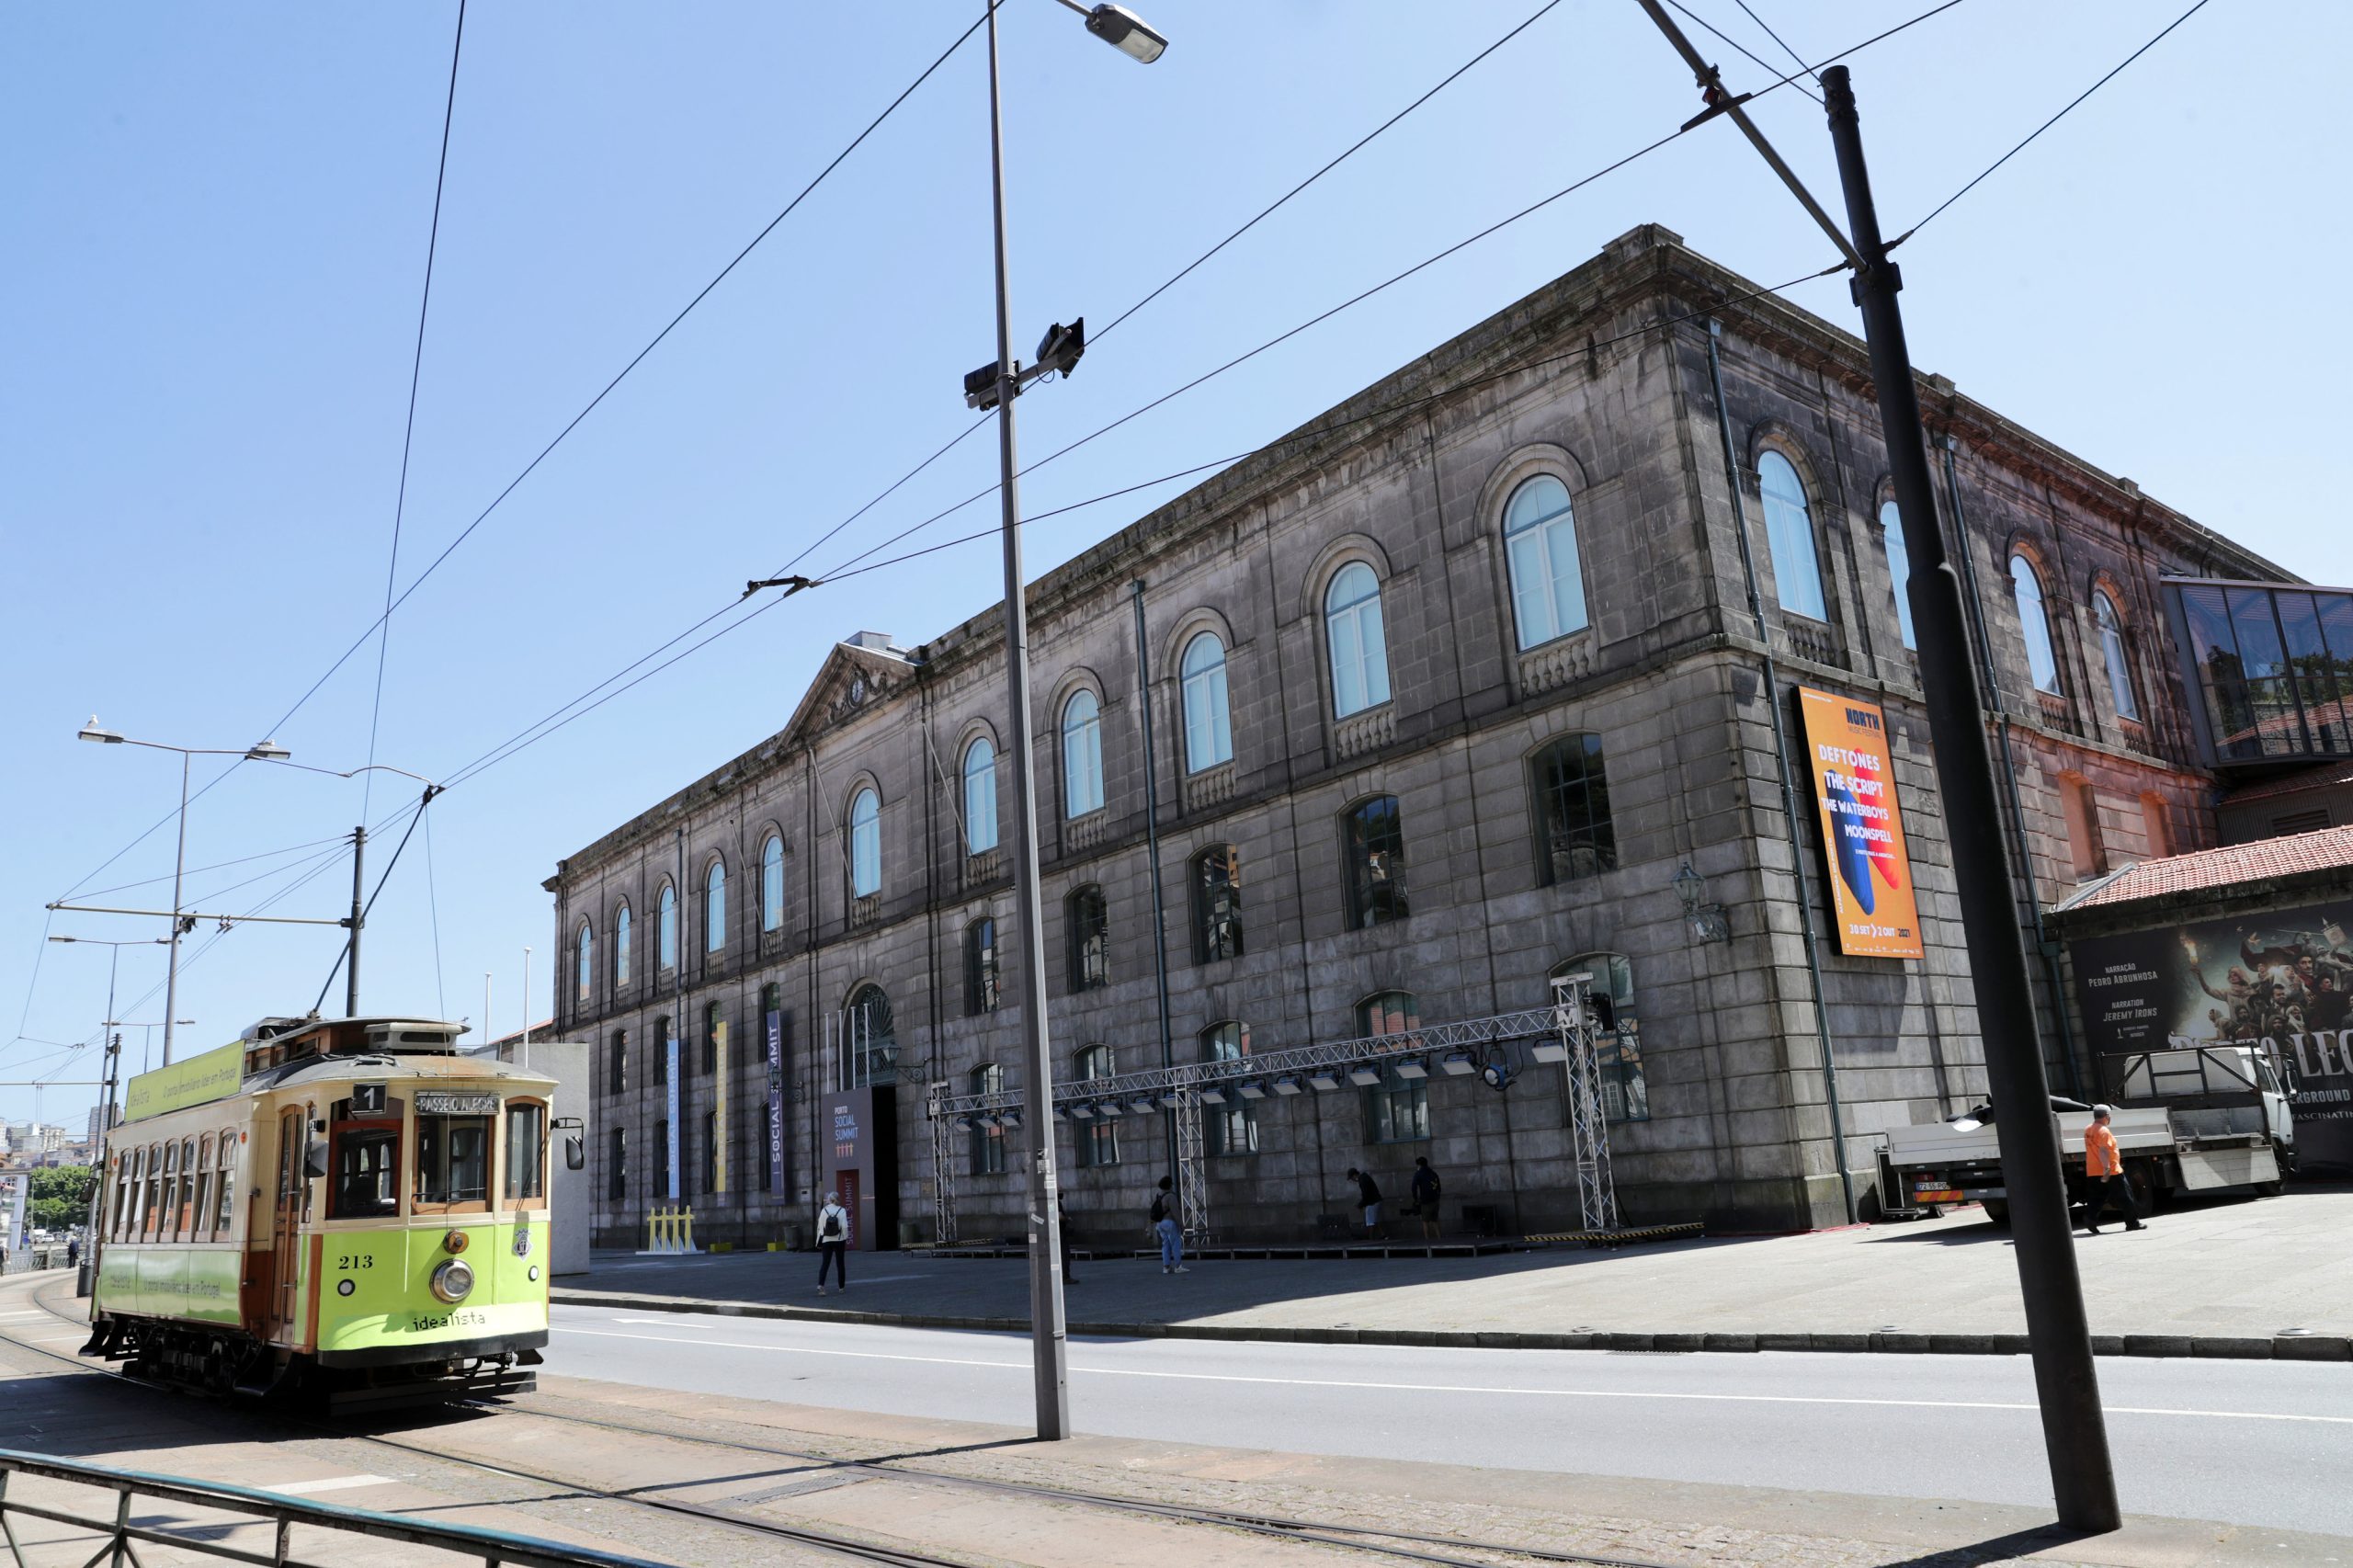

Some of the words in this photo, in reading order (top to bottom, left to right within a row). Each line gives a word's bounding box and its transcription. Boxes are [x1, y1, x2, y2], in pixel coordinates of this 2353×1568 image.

[1845, 708, 1880, 731] NORTH
[1818, 744, 1881, 771] DEFTONES
[1824, 771, 1846, 790] THE
[1847, 777, 1883, 798] SCRIPT
[1821, 797, 1837, 812] THE
[1837, 801, 1889, 821] WATERBOYS
[1845, 824, 1893, 843] MOONSPELL
[2088, 977, 2111, 987] PEDRO
[2114, 971, 2158, 984] ABRUNHOSA
[2111, 999, 2144, 1009] NARRATION
[2103, 1011, 2132, 1022] JEREMY
[2135, 1007, 2157, 1018] IRONS
[364, 1087, 375, 1109] 1
[420, 1097, 458, 1111] PASSEIO
[461, 1096, 495, 1111] ALEGRE
[835, 1106, 847, 1115] PORTO
[835, 1115, 856, 1128] SOCIAL
[772, 1100, 780, 1163] SOCIAL
[835, 1127, 858, 1141] SUMMIT
[845, 1176, 853, 1211] SUMMIT
[338, 1255, 373, 1269] 213
[413, 1312, 485, 1332] idealista
